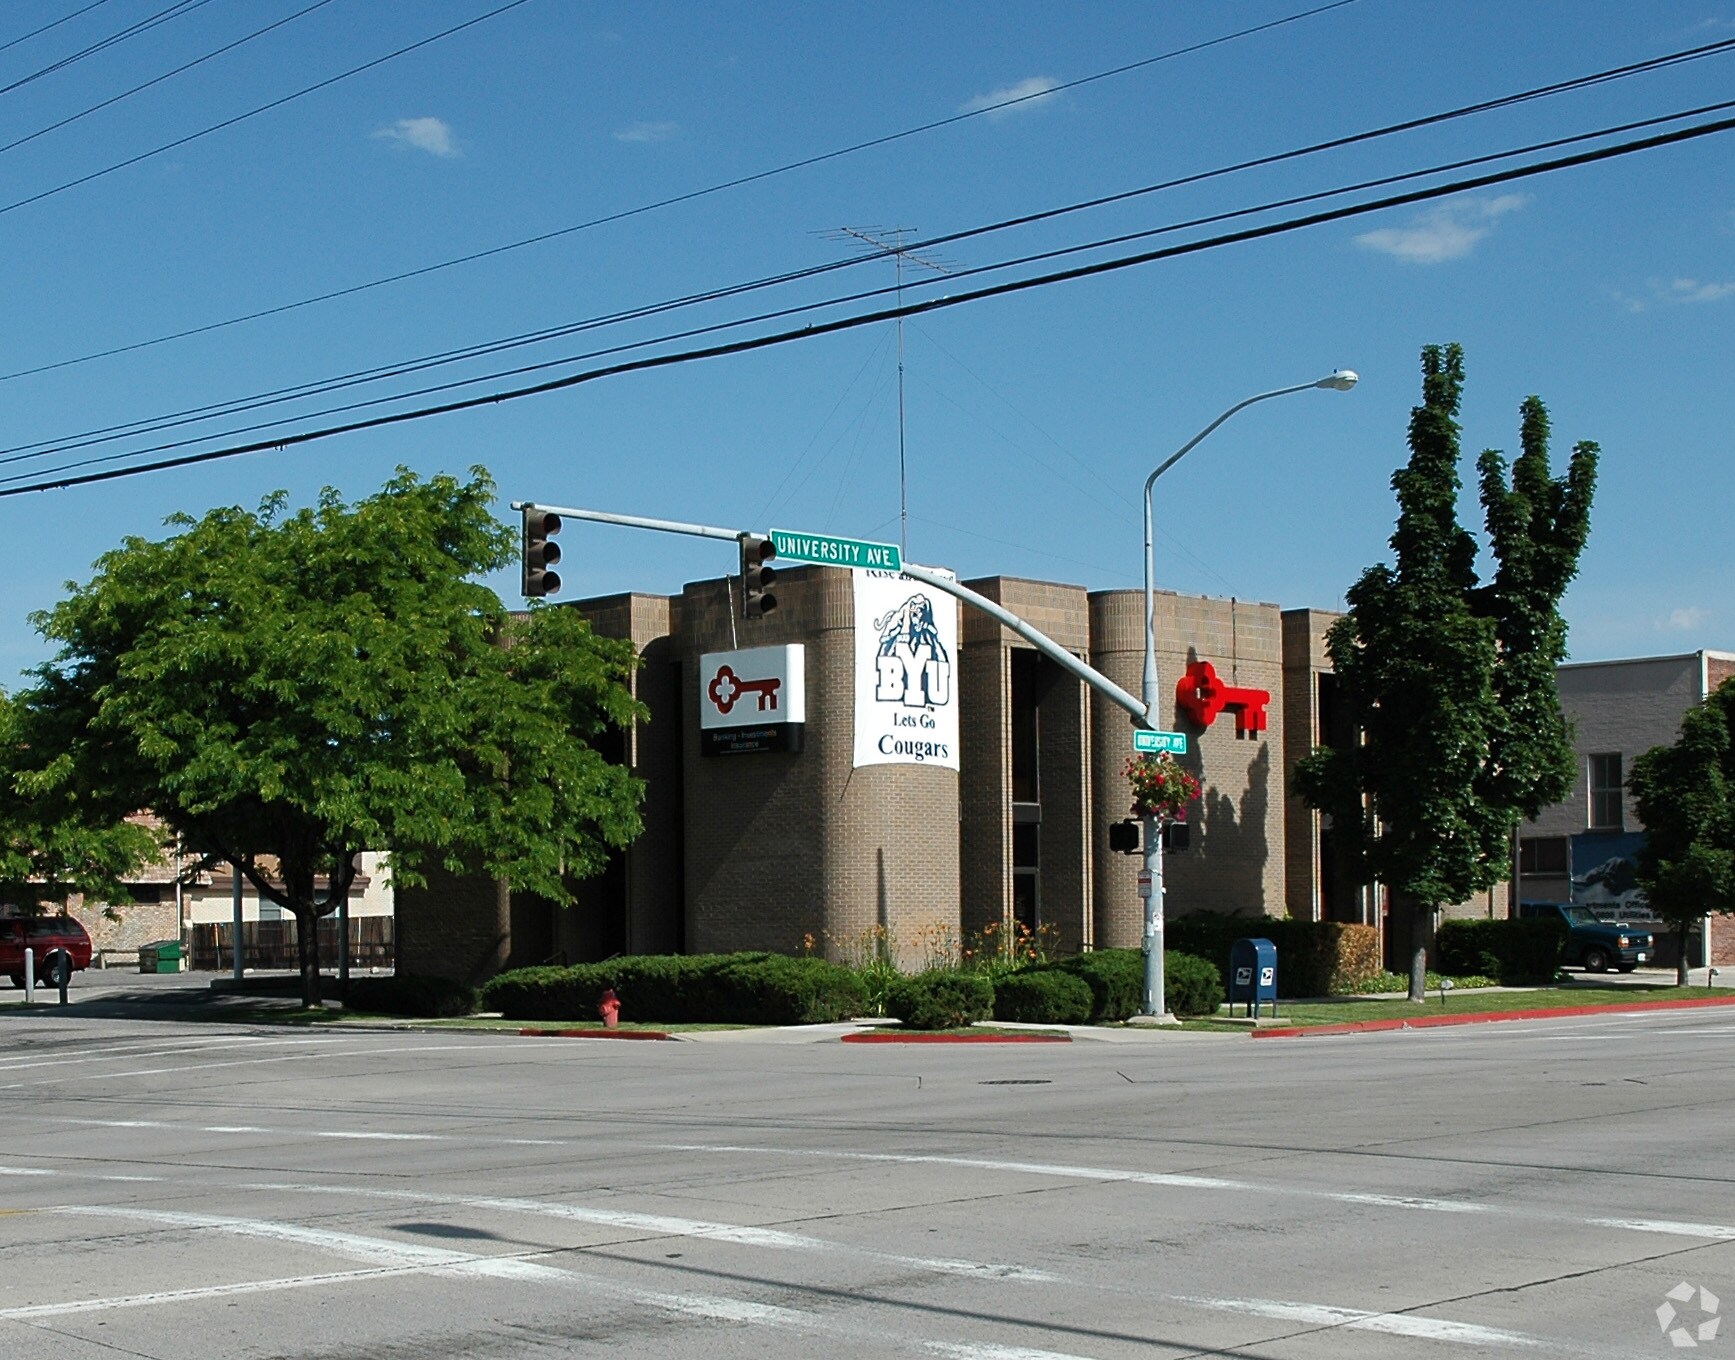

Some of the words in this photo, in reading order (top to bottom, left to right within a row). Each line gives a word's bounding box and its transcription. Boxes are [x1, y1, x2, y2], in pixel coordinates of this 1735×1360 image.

[777, 536, 859, 561] UNIVERSITY
[876, 641, 950, 708] BYU
[893, 712, 917, 727] Lets
[919, 714, 936, 729] Go
[878, 734, 949, 761] Cougars
